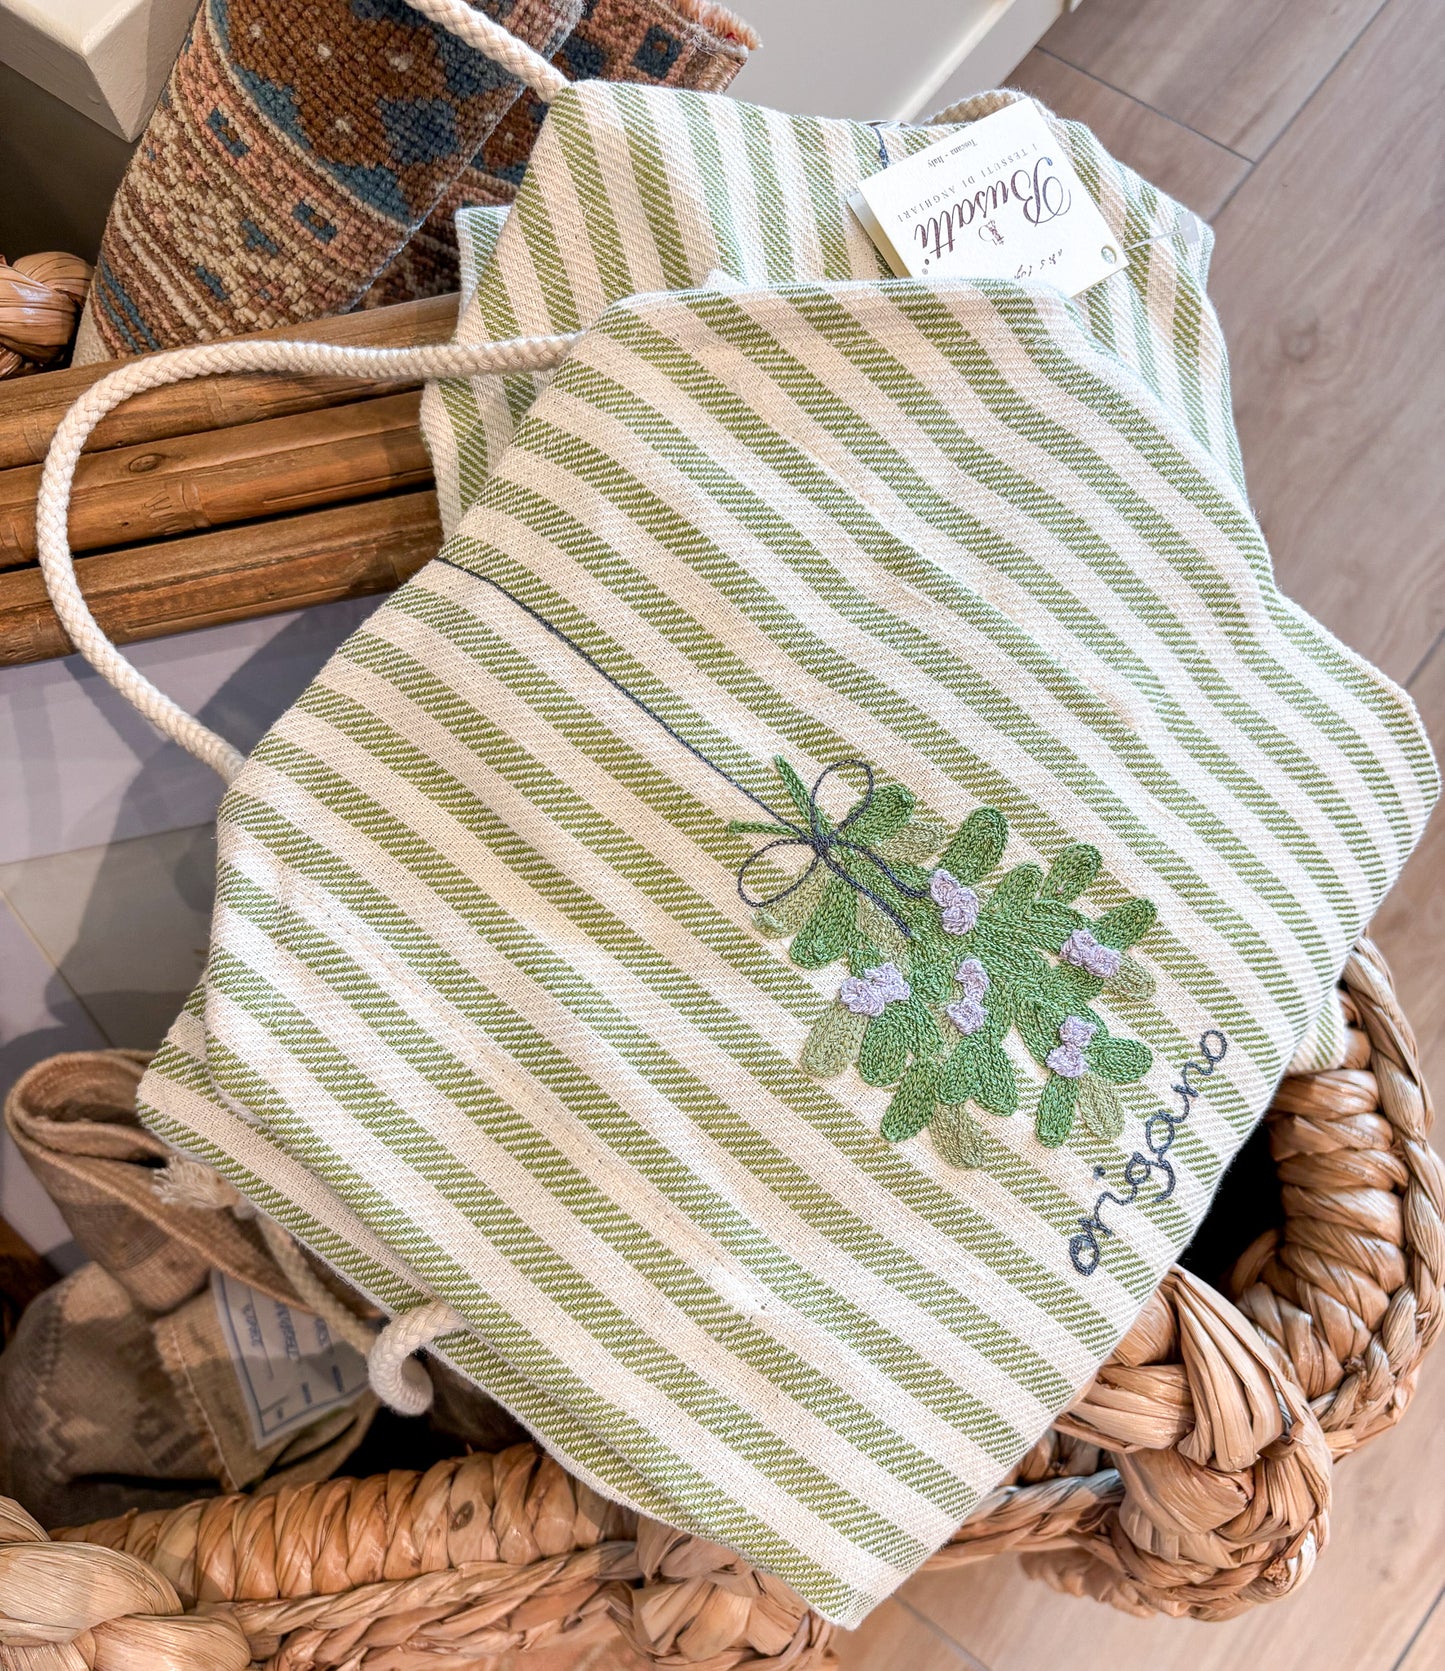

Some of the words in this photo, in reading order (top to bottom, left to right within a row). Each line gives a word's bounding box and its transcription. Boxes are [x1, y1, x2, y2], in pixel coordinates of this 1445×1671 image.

[927, 154, 944, 169] Italy
[949, 138, 978, 156] Toscana
[981, 148, 1028, 178] TESSUTI
[962, 175, 976, 188] DI
[897, 185, 956, 223] ANGHIARI
[914, 156, 1072, 265] Busatti
[1069, 1029, 1228, 1276] origano
